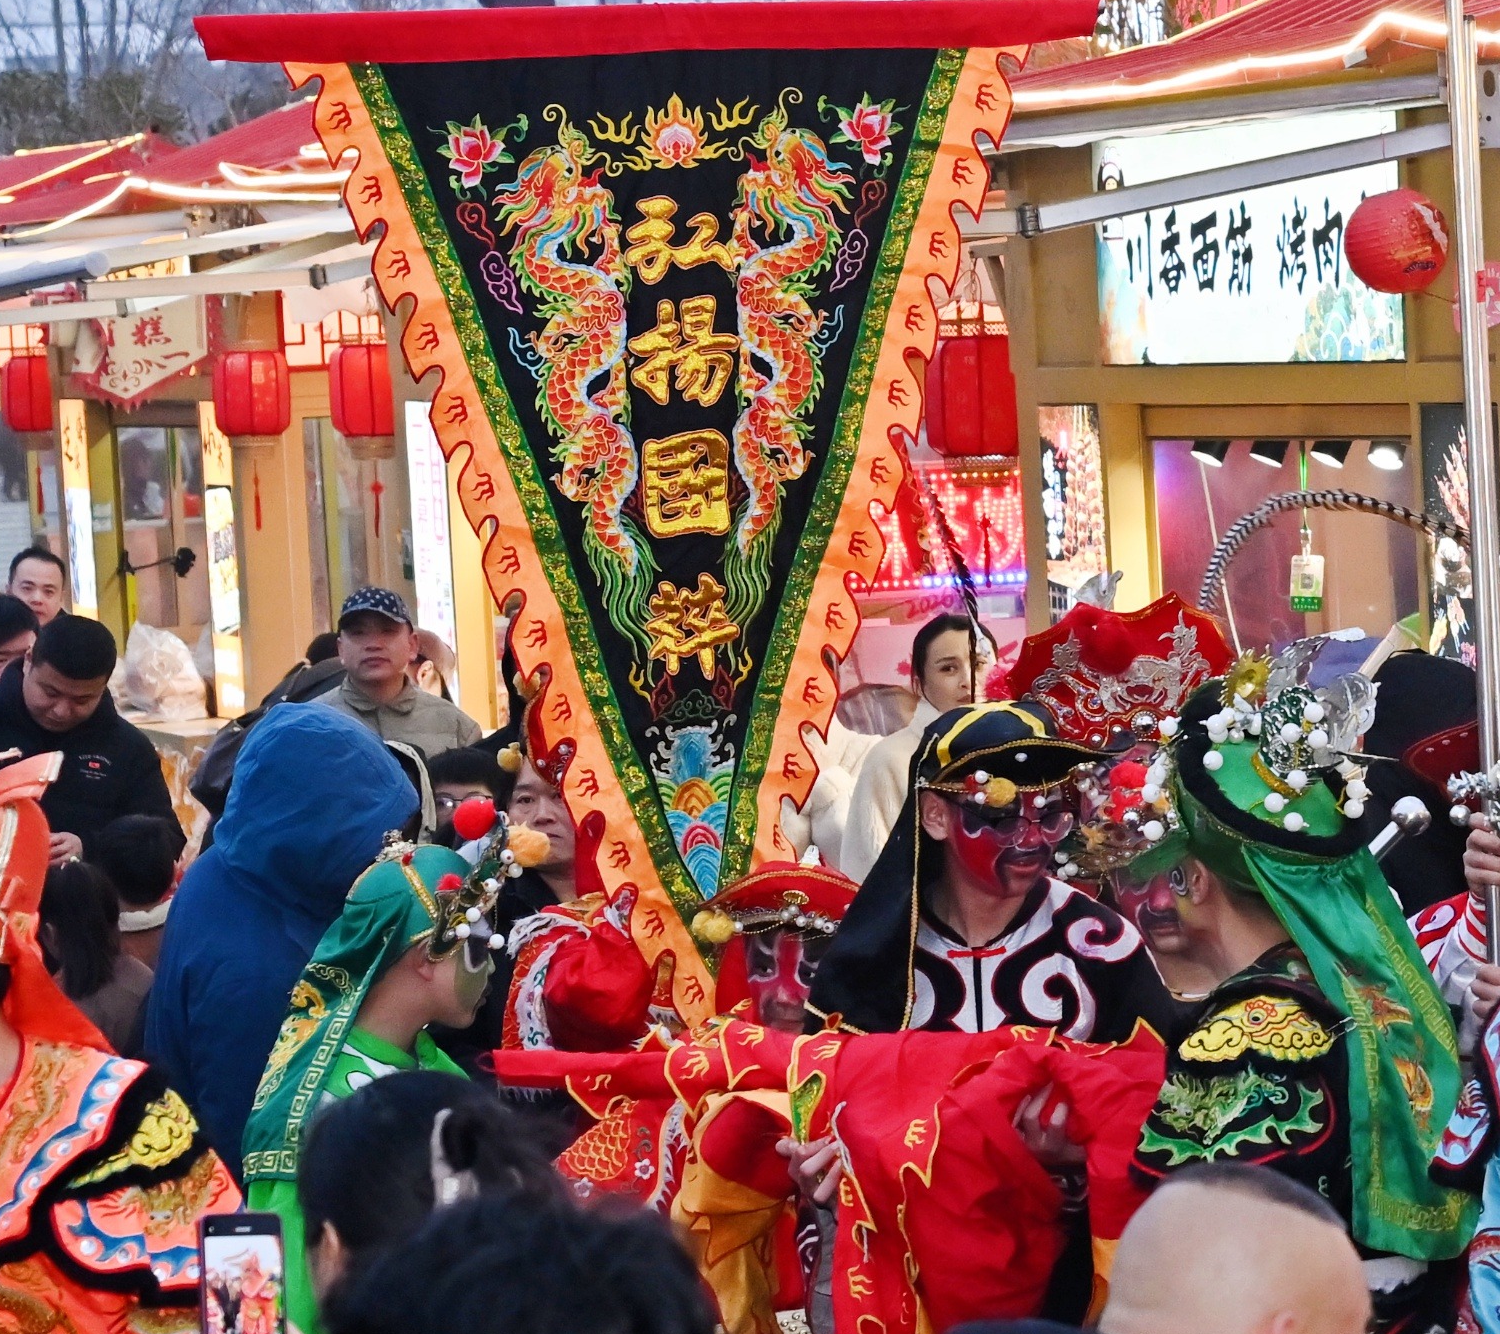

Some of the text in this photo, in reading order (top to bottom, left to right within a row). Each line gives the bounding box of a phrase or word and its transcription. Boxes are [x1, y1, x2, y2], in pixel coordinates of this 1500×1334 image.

[1126, 191, 1368, 301] 川香面筋 烤肉
